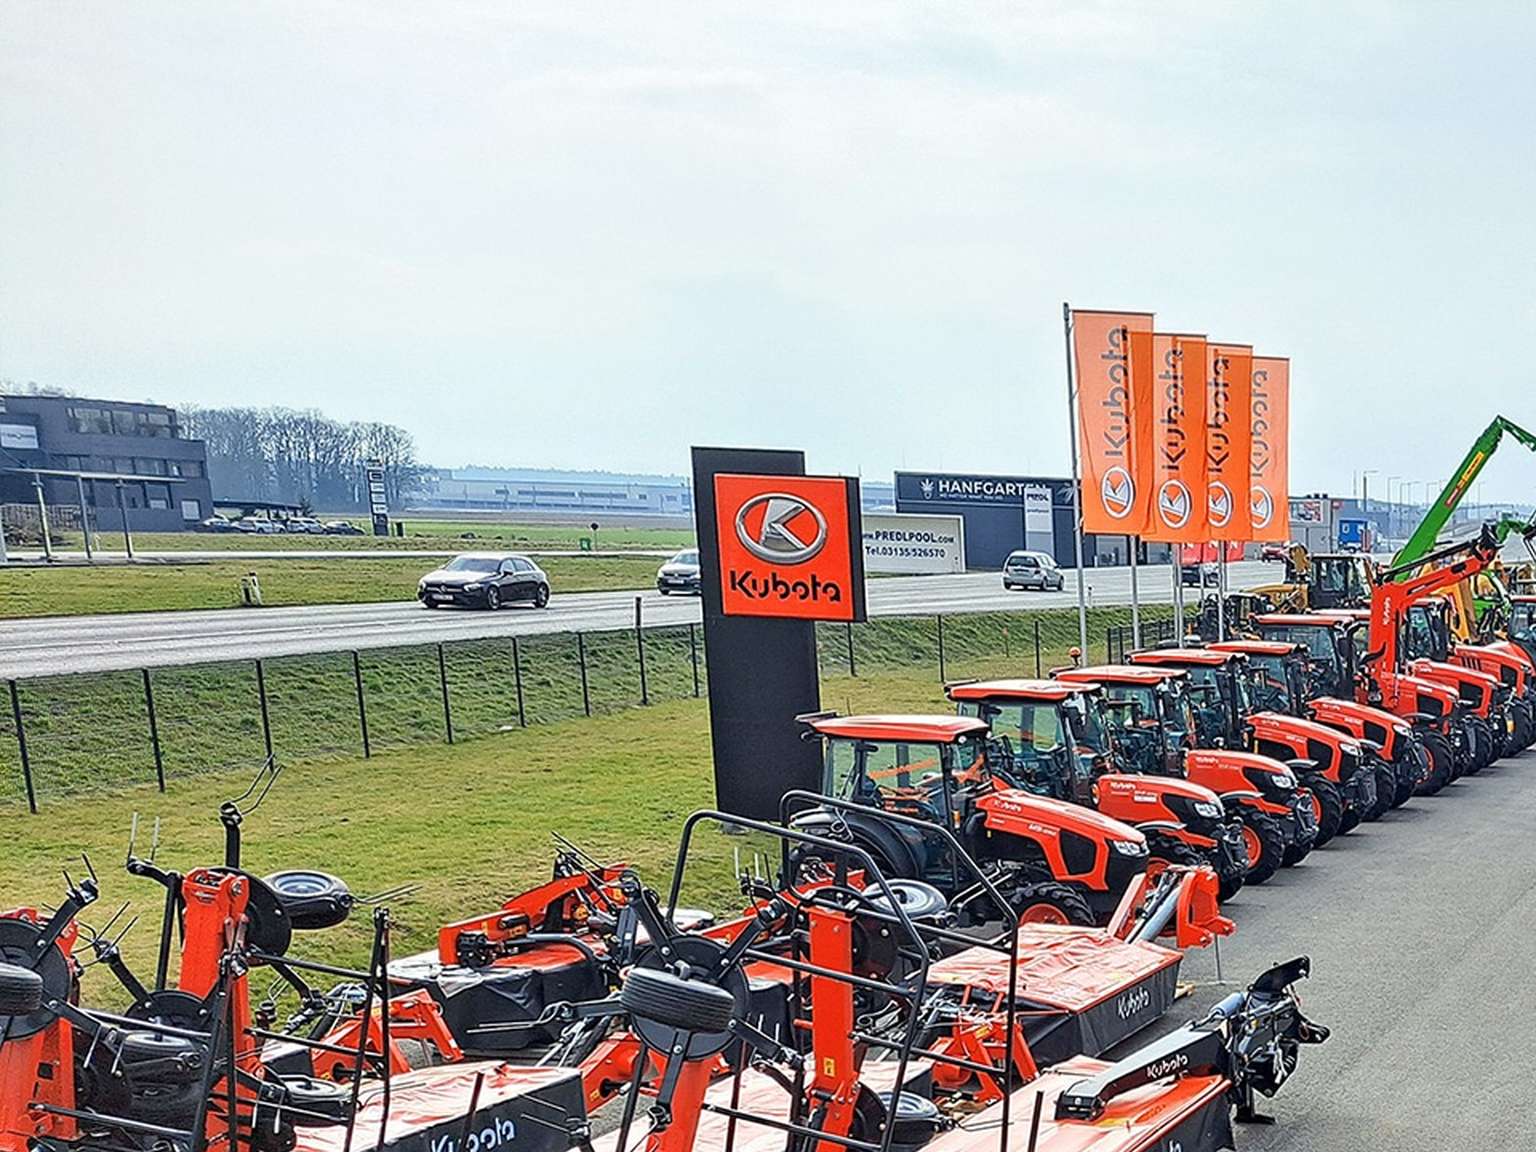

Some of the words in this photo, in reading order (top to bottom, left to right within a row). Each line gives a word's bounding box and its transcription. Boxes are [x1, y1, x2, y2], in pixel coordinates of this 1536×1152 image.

[1101, 325, 1130, 456] Kubota
[1158, 347, 1186, 471] Kubota
[1207, 357, 1230, 472] Kubota
[730, 570, 841, 602] Kubota
[1117, 986, 1149, 1019] Kubota
[1147, 1054, 1188, 1079] Kubota
